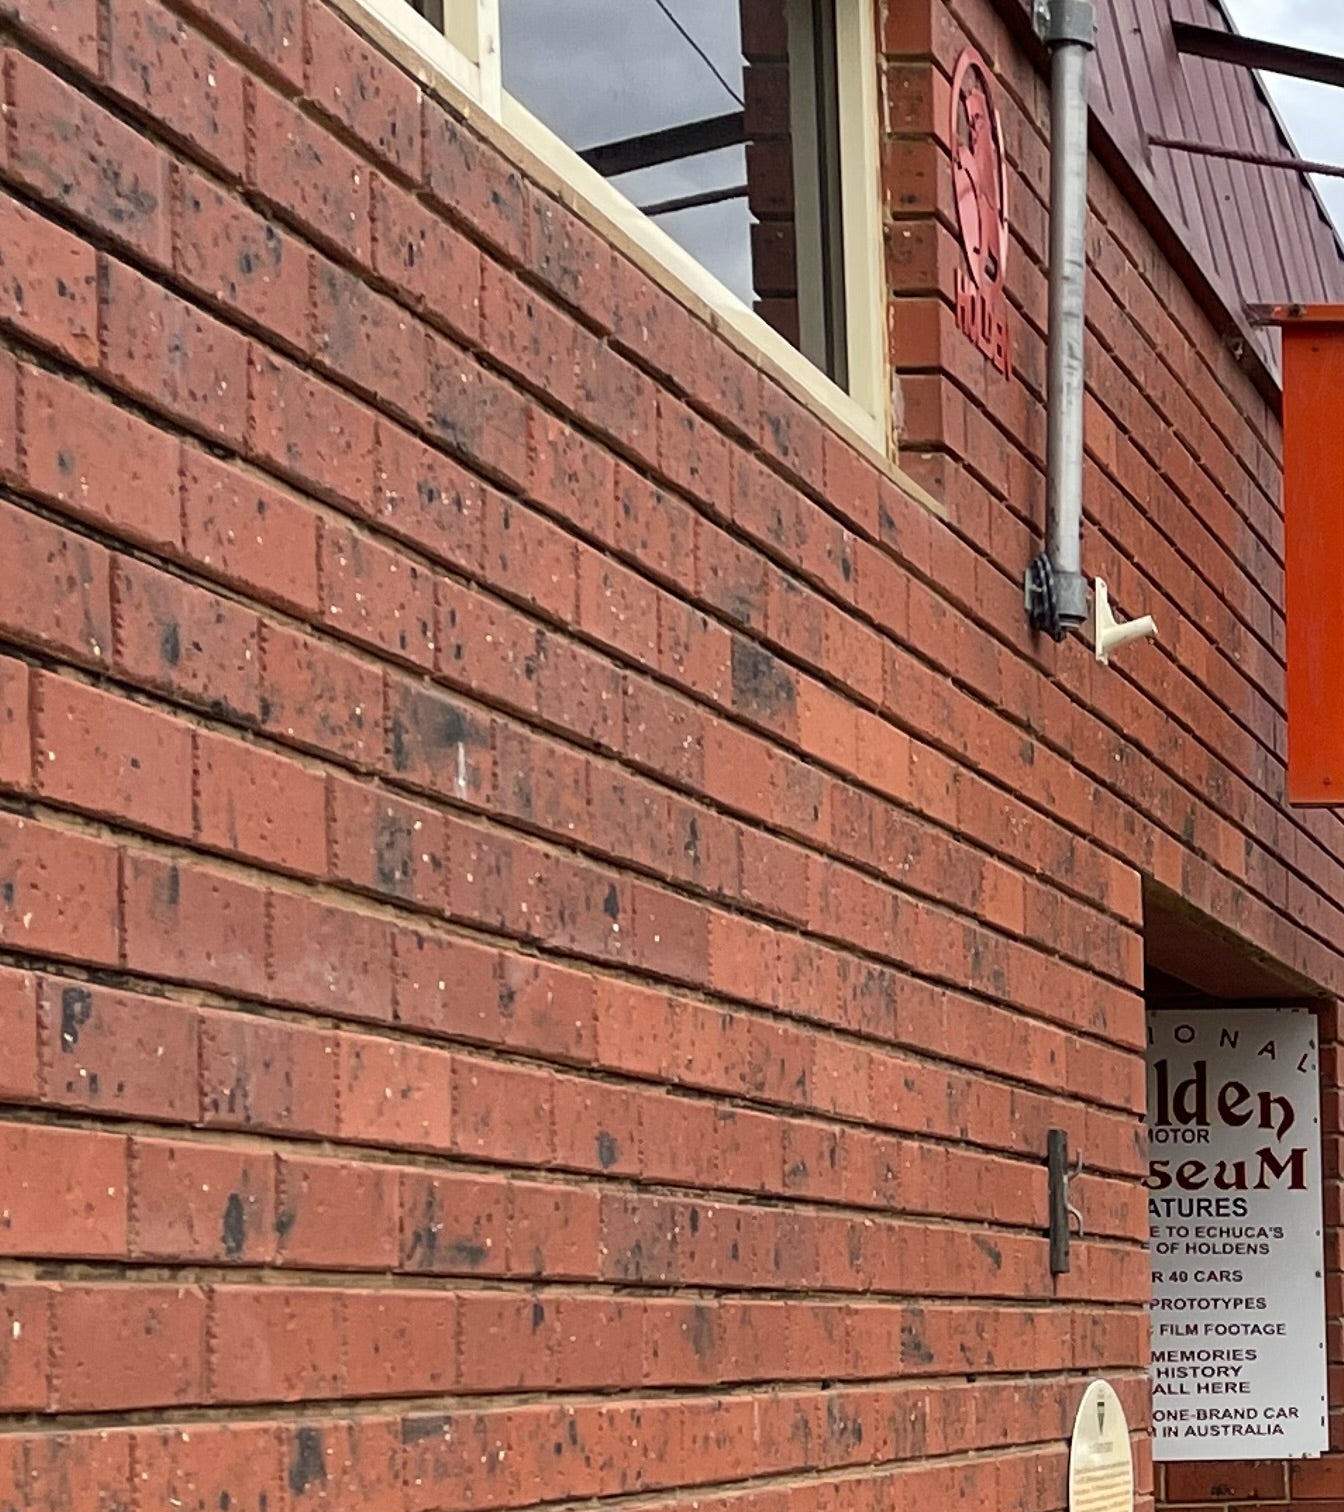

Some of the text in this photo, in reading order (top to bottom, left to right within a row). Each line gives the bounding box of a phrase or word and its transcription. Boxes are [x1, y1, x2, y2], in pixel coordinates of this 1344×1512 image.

[1166, 1226, 1190, 1238] TO
[1195, 1226, 1285, 1239] ECHUCA'S
[1156, 1242, 1180, 1255] OF
[1185, 1242, 1270, 1255] HOLDENS
[1168, 1270, 1189, 1283] 40
[1193, 1270, 1243, 1283] CARS
[1150, 1297, 1267, 1310] PROTOTYPES
[1160, 1323, 1199, 1336] FILM
[1203, 1323, 1287, 1336] FOOTAGE
[1151, 1349, 1258, 1362] MEMORIES
[1156, 1366, 1243, 1379] HISTORY
[1152, 1381, 1252, 1396] ALL HERE
[1152, 1407, 1299, 1421] ONE-BRAND CAR
[1162, 1426, 1179, 1438] IN
[1184, 1424, 1285, 1438] AUSTRALIA
